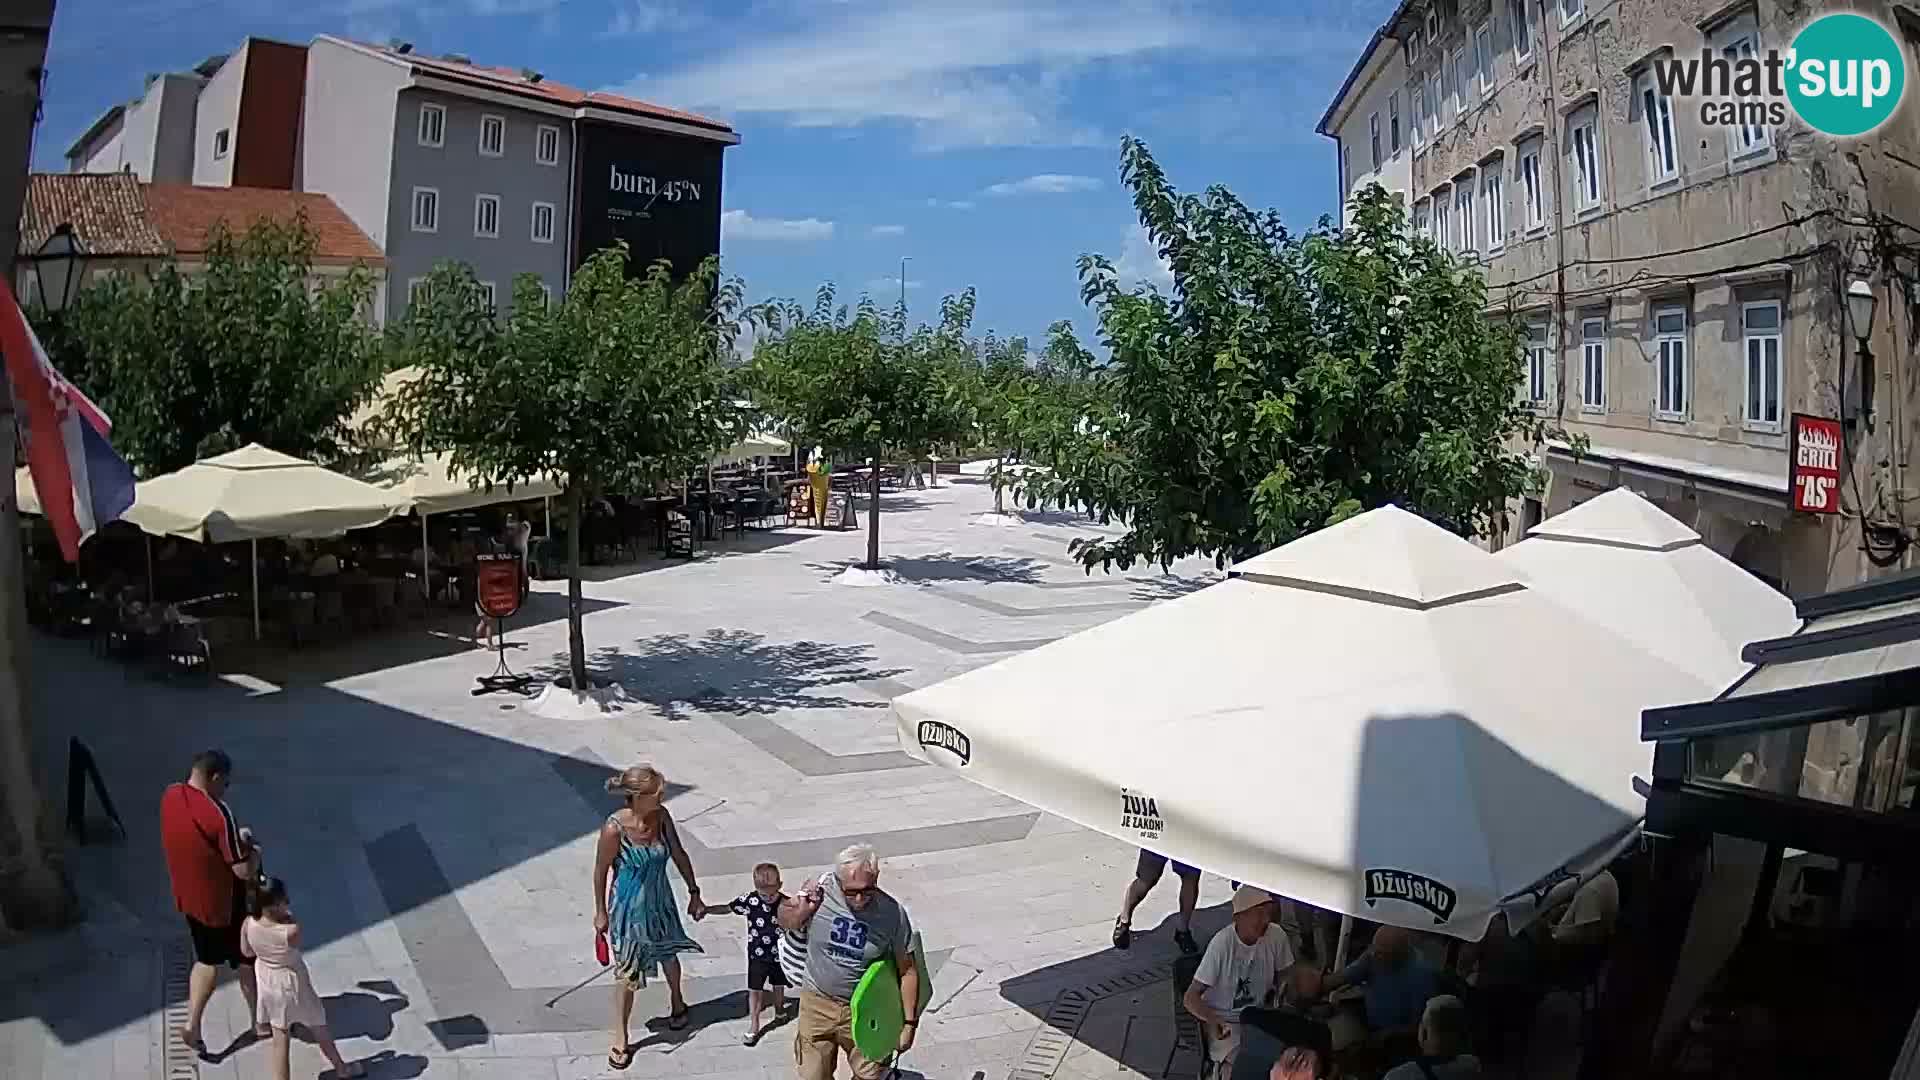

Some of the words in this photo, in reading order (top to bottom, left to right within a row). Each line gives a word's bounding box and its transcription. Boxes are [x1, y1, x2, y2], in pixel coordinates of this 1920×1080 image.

[610, 164, 656, 195] bura
[1797, 446, 1838, 471] GRILL
[1121, 787, 1160, 819] ŽUJA
[1120, 815, 1131, 828] JE
[1372, 871, 1449, 912] Ožujsko
[830, 916, 868, 950] 33
